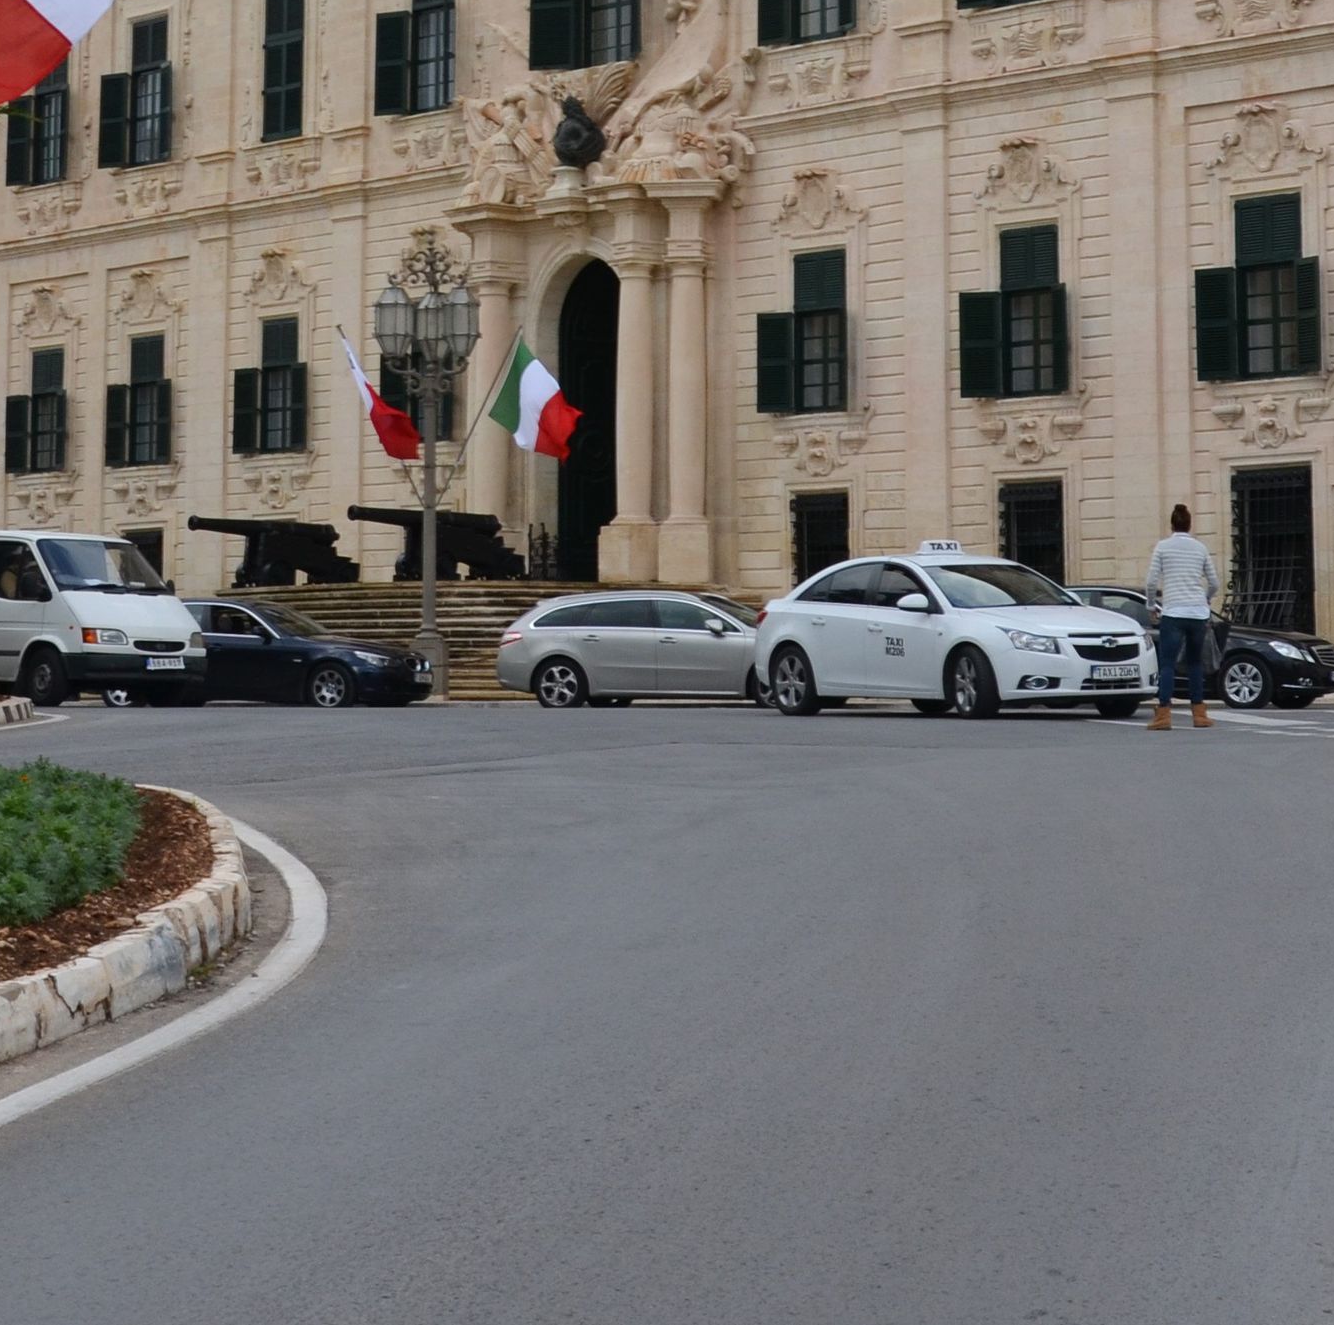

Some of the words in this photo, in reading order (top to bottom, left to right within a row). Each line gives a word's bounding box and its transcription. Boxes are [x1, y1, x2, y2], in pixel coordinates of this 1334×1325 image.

[929, 542, 958, 551] TAXI
[885, 636, 904, 647] TAXI
[885, 647, 906, 657] M206
